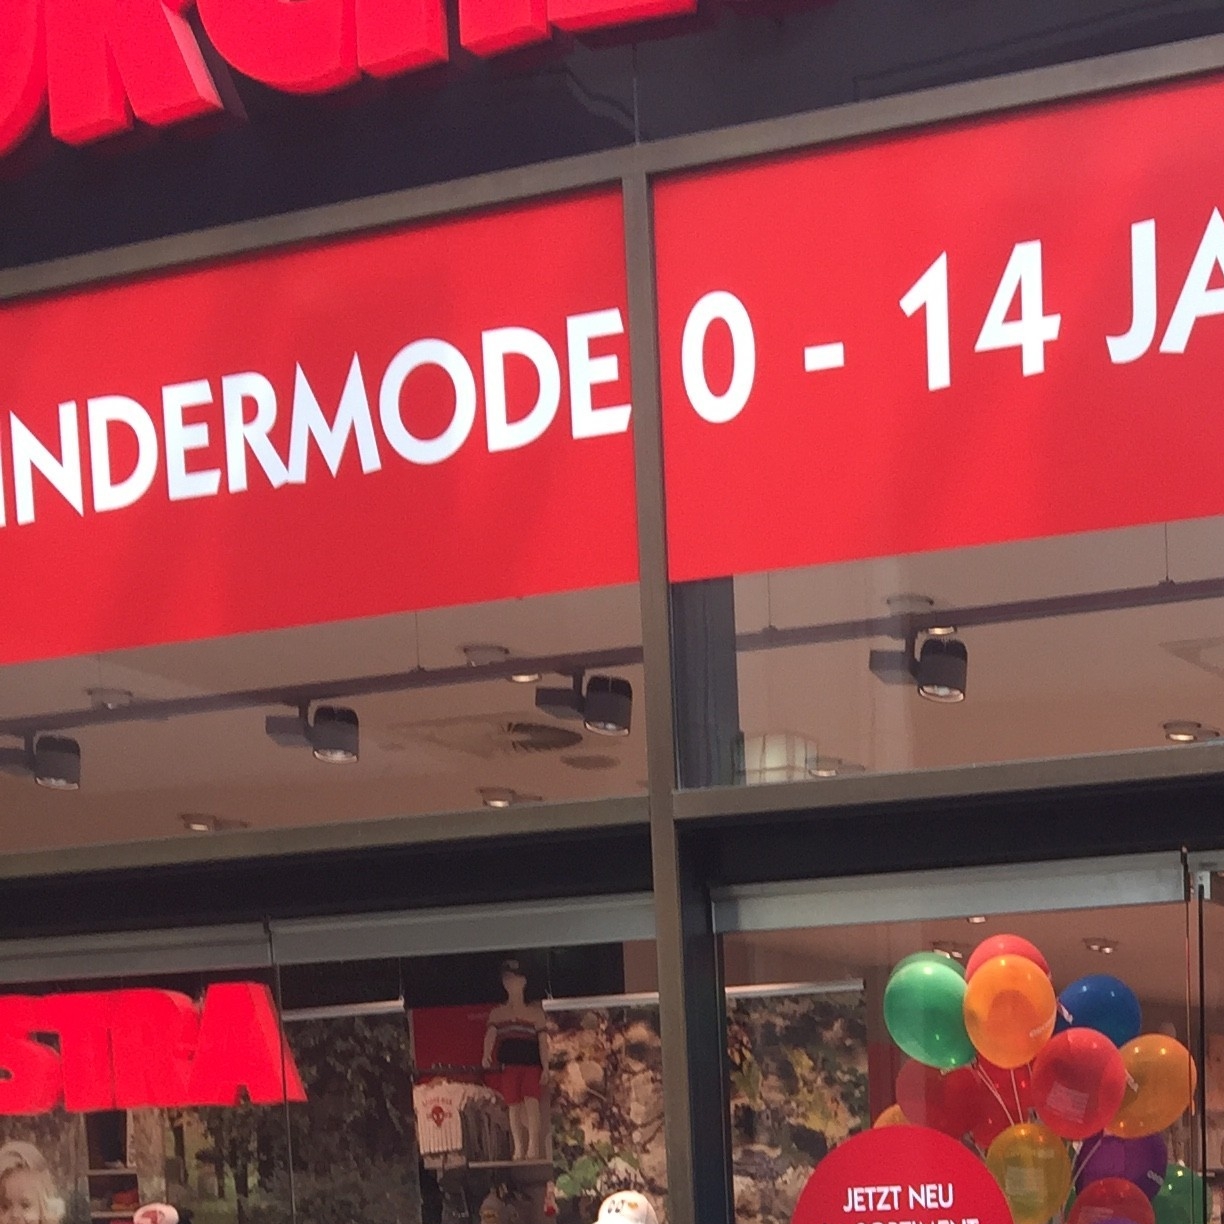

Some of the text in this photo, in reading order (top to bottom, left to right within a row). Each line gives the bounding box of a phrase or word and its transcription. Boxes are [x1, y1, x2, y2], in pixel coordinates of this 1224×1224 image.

[0, 307, 631, 527] NDERMODE
[682, 291, 756, 423] 0
[899, 239, 1061, 392] 14
[843, 1183, 953, 1212] JETZT NEU
